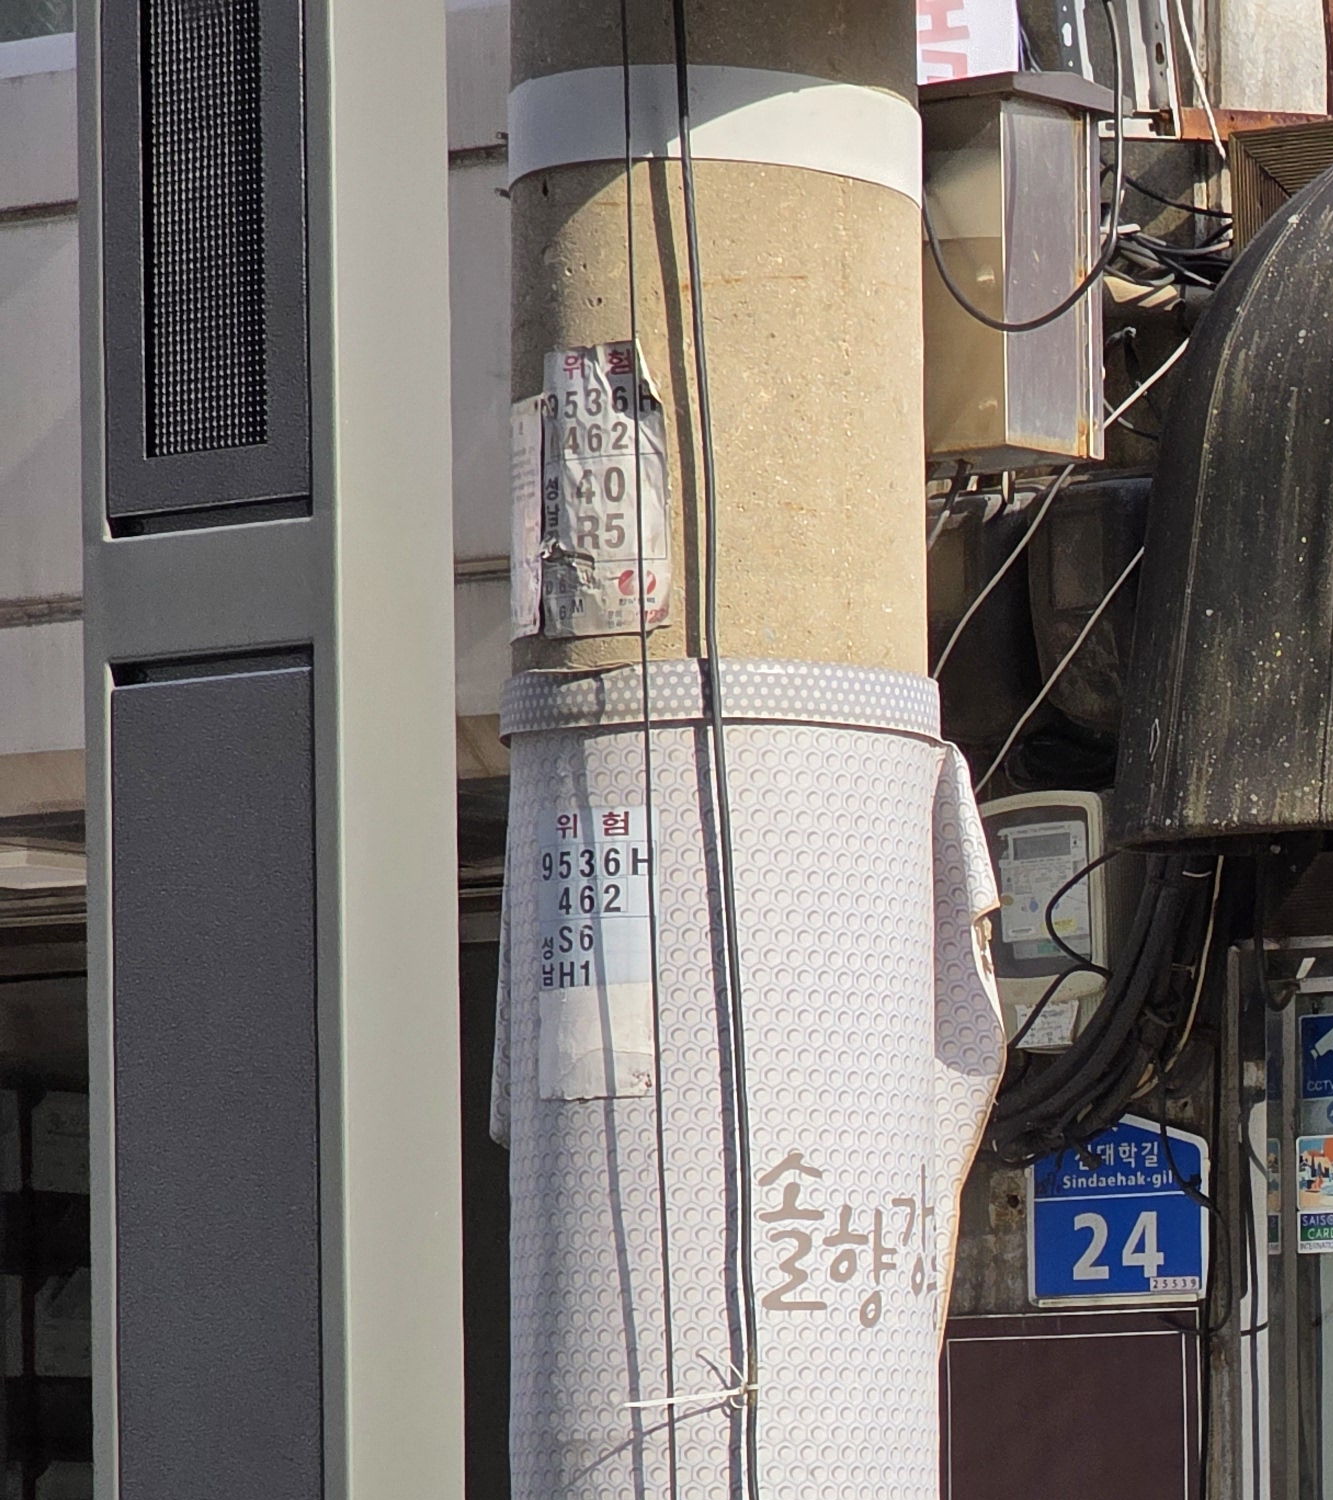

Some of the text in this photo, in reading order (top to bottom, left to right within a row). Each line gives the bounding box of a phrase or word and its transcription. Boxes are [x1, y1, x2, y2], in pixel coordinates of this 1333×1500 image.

[566, 420, 630, 455] 462
[576, 466, 626, 505] 40
[576, 512, 627, 551] R5
[541, 846, 652, 882] 9536H
[558, 883, 622, 916] 462
[558, 924, 594, 954] S6
[558, 960, 591, 989] H1
[1062, 1170, 1174, 1190] Sindaehak-gil
[758, 1152, 938, 1332] 솔향강
[1072, 1210, 1165, 1281] 24
[1152, 1278, 1198, 1290] 25539
